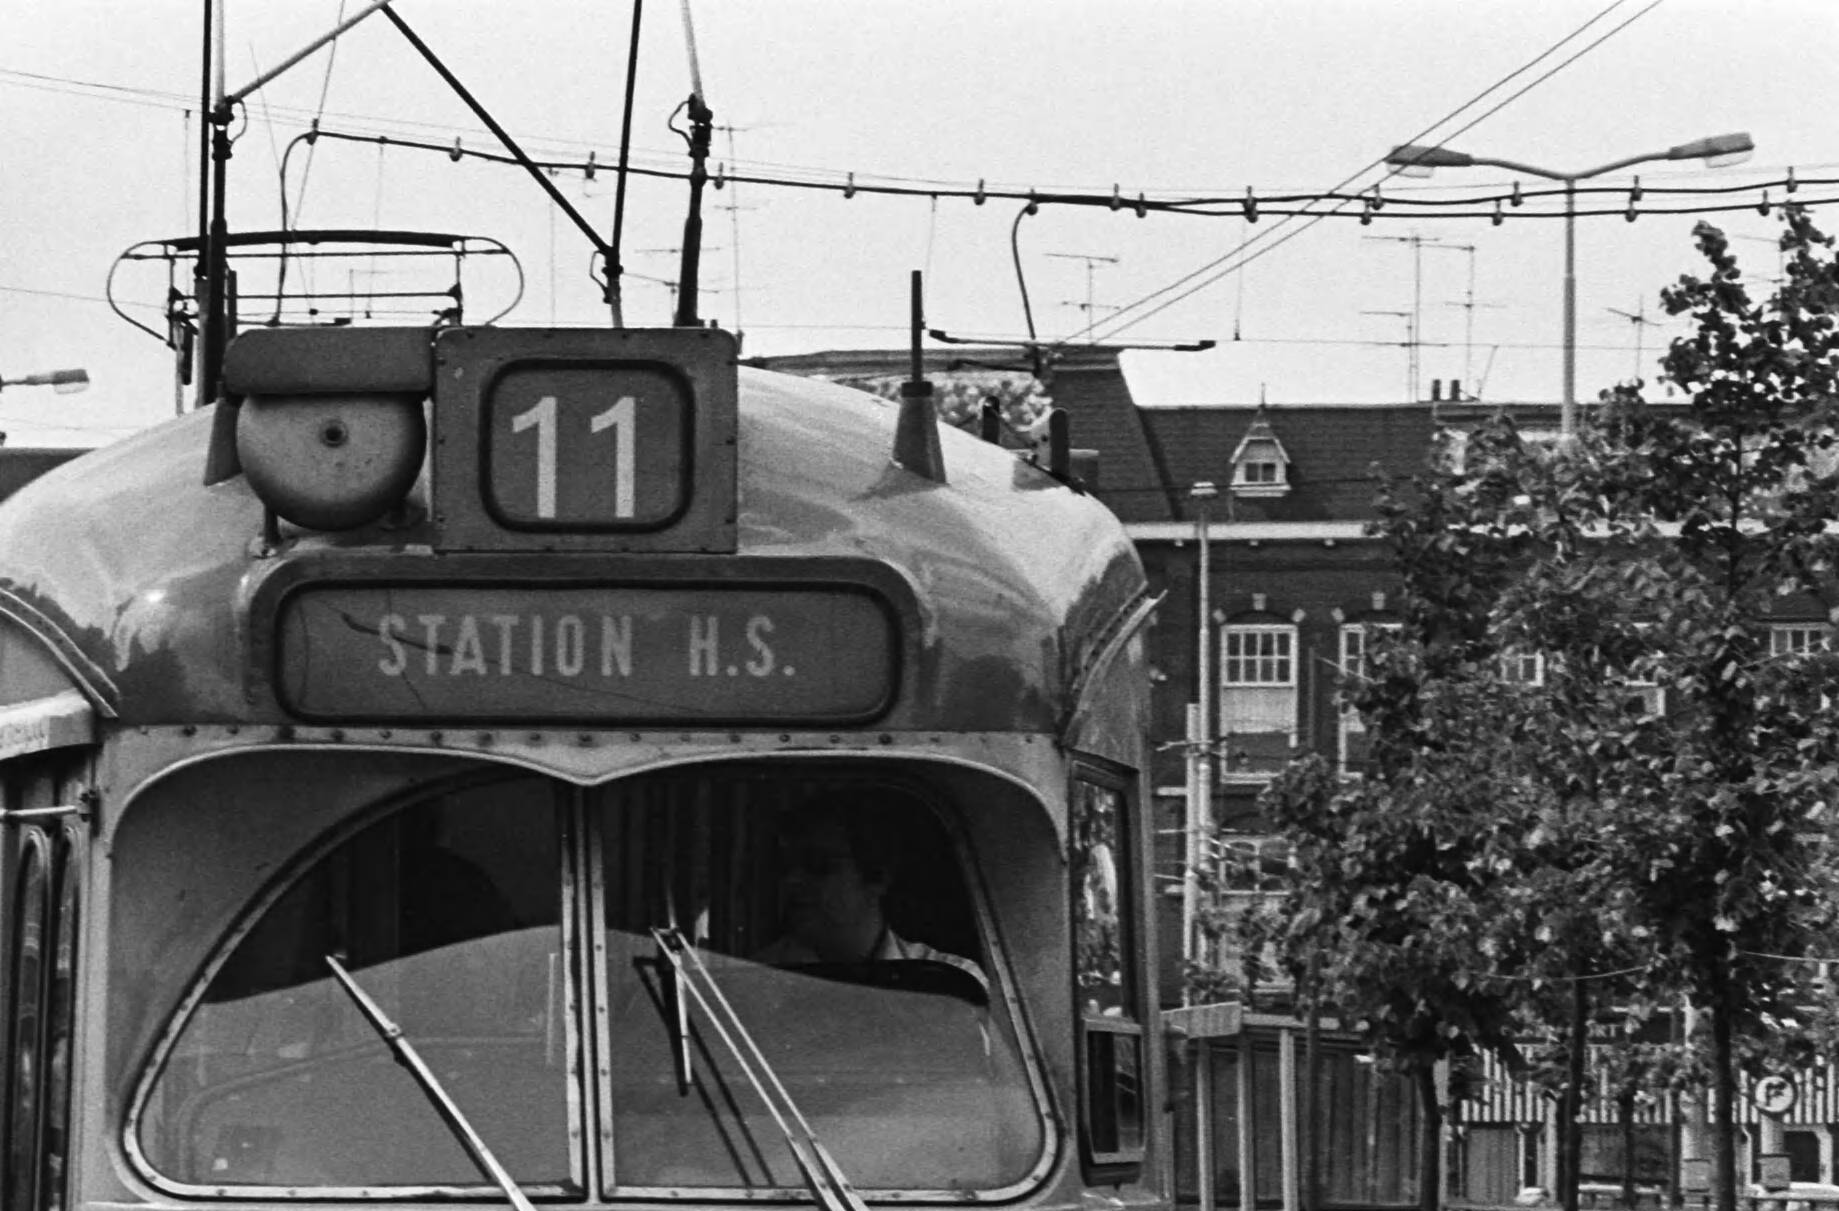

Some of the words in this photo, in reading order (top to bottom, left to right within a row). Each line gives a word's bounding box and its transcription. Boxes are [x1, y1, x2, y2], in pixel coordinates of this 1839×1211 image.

[512, 396, 636, 519] 11
[378, 614, 632, 677] STATION
[689, 614, 797, 677] H.S.
